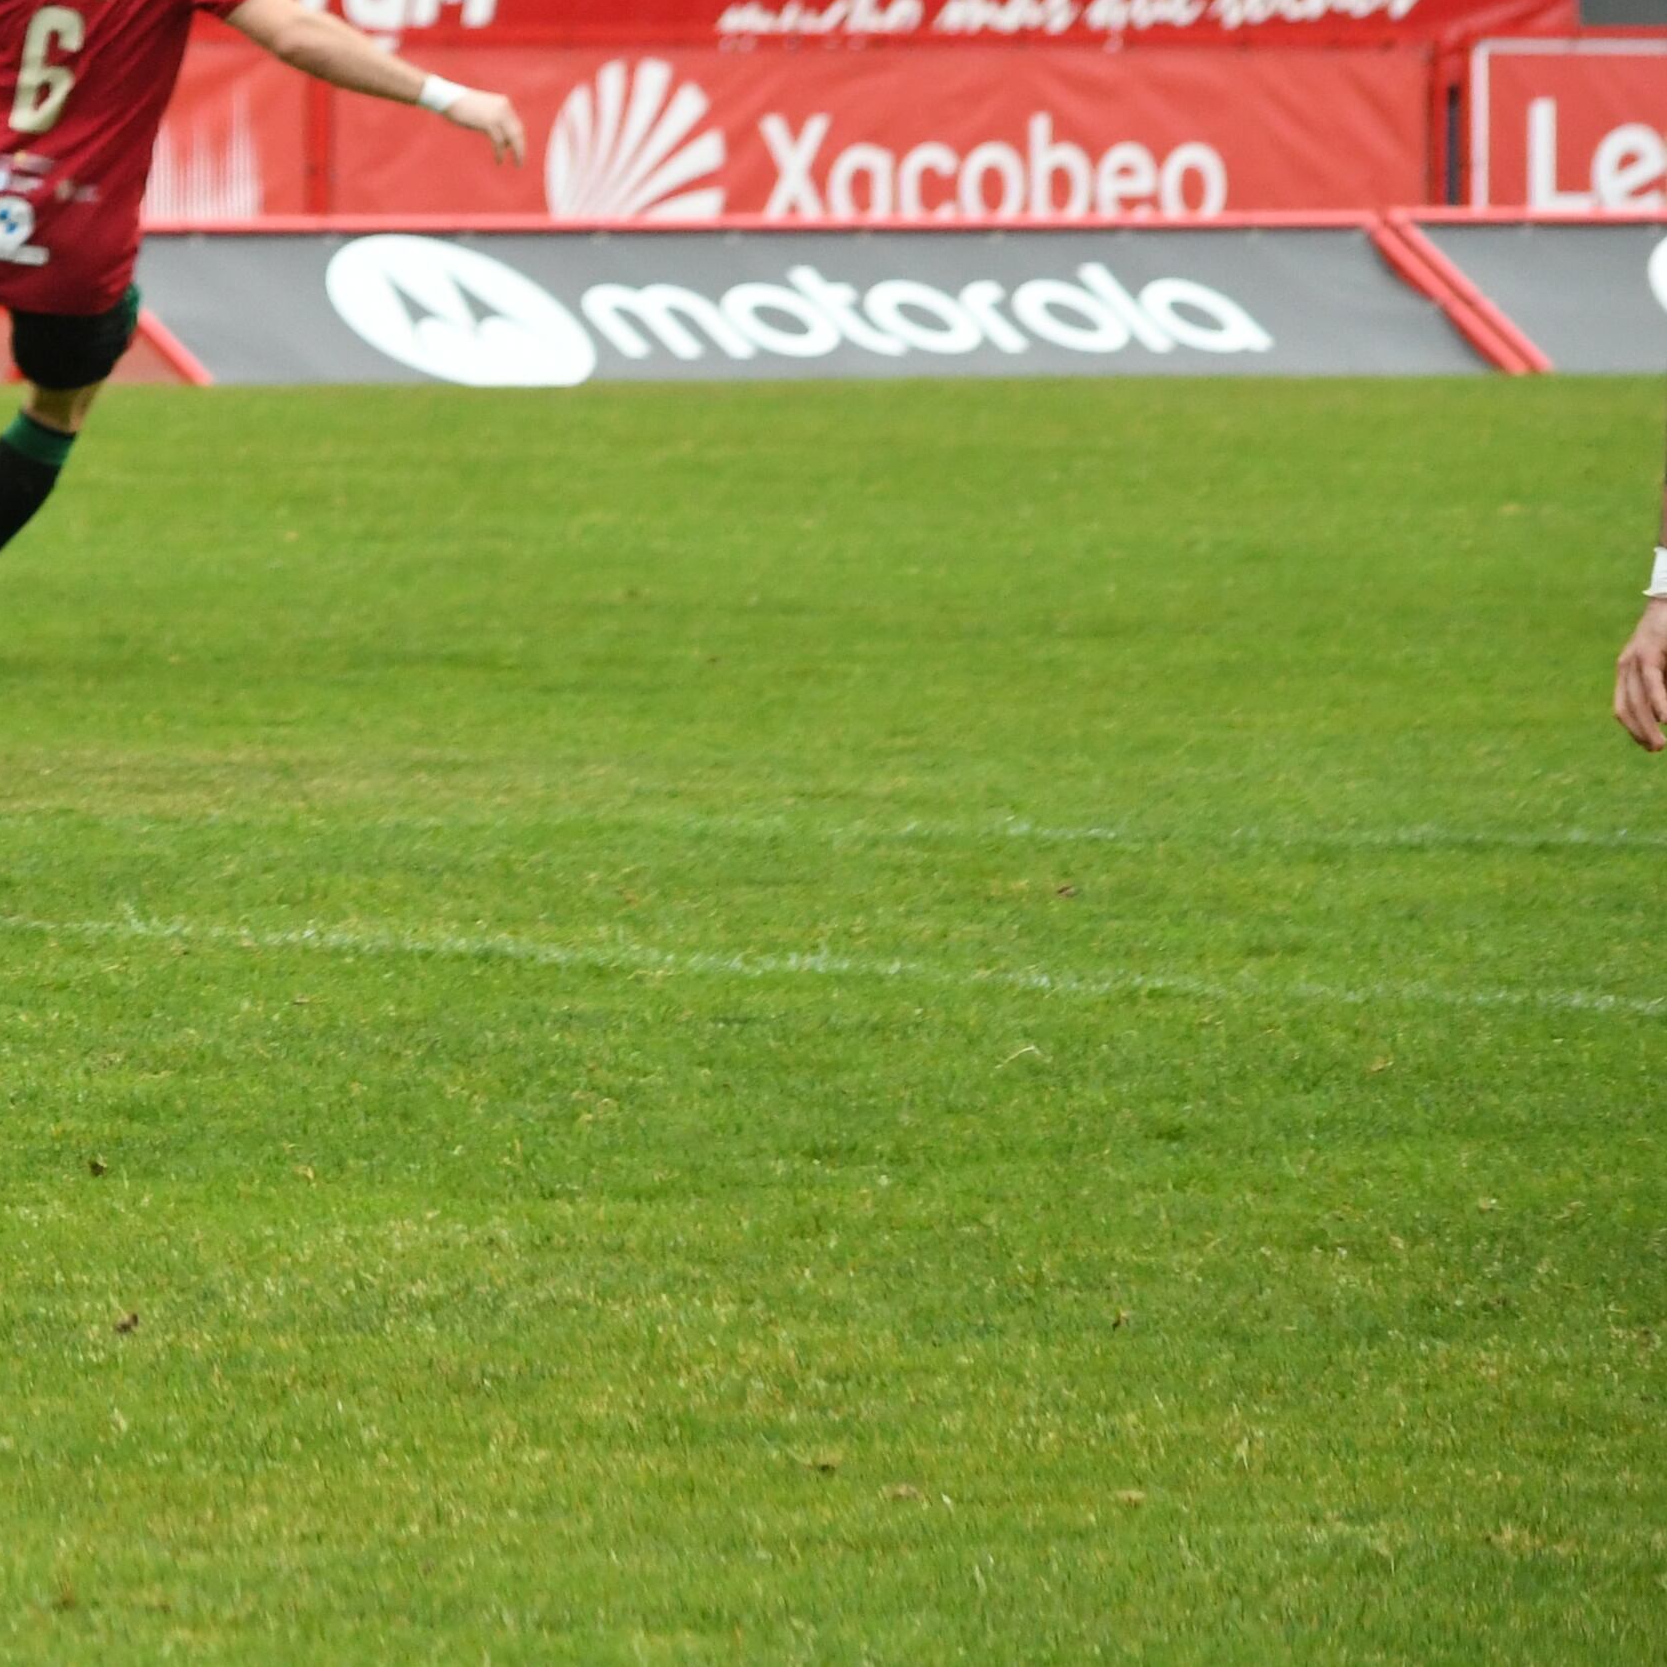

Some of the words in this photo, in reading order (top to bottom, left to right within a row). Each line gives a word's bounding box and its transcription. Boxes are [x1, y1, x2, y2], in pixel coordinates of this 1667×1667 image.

[7, 4, 86, 133] 6
[760, 111, 1228, 221] Xacobeo
[581, 263, 1274, 361] motorola
